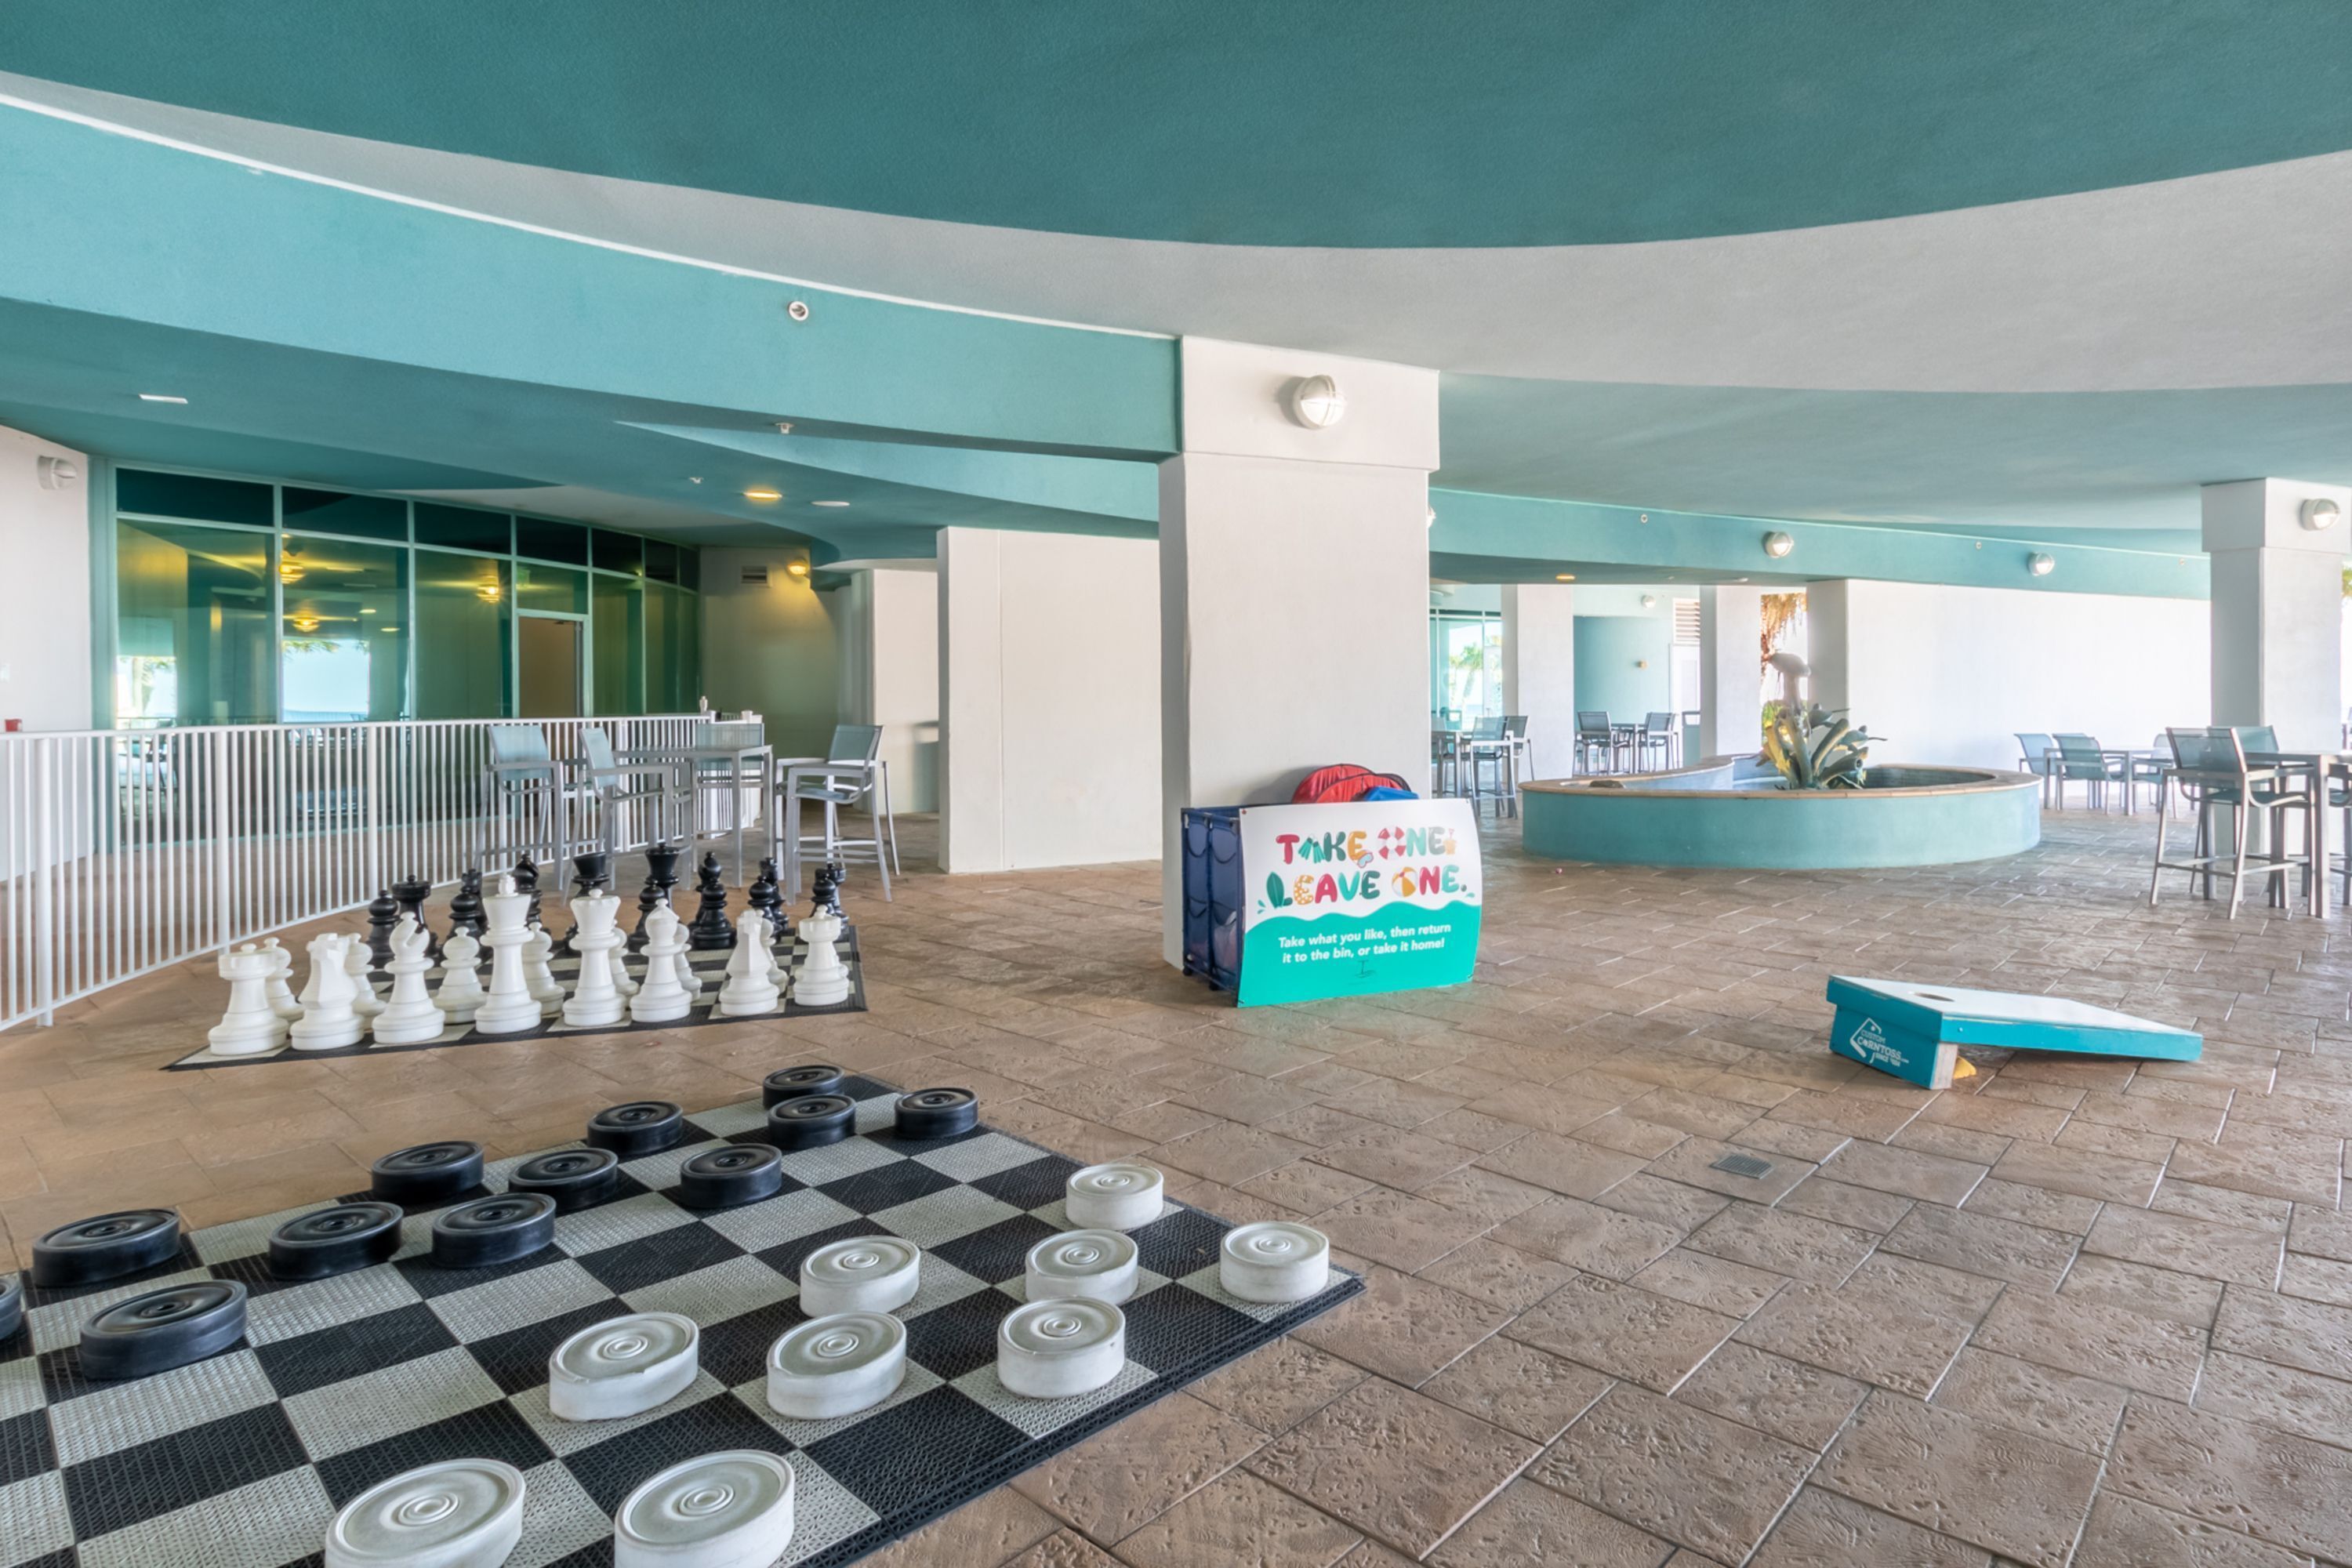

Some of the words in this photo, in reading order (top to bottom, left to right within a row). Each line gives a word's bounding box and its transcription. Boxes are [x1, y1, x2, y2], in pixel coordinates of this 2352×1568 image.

[1276, 831, 1367, 866] TAKE
[1266, 870, 1381, 909] LEAVE
[1278, 935, 1305, 948] Take
[1308, 933, 1338, 946] what
[1340, 933, 1361, 946] you
[1364, 928, 1387, 940] like,
[1390, 926, 1415, 938] then
[1418, 924, 1451, 935] return
[1283, 953, 1291, 964] it
[1294, 953, 1307, 963] to
[1311, 949, 1330, 961] the
[1333, 947, 1354, 959] bin,
[1358, 947, 1370, 956] or
[1374, 942, 1397, 954] take
[1400, 941, 1409, 952] it
[1411, 937, 1445, 951] home!
